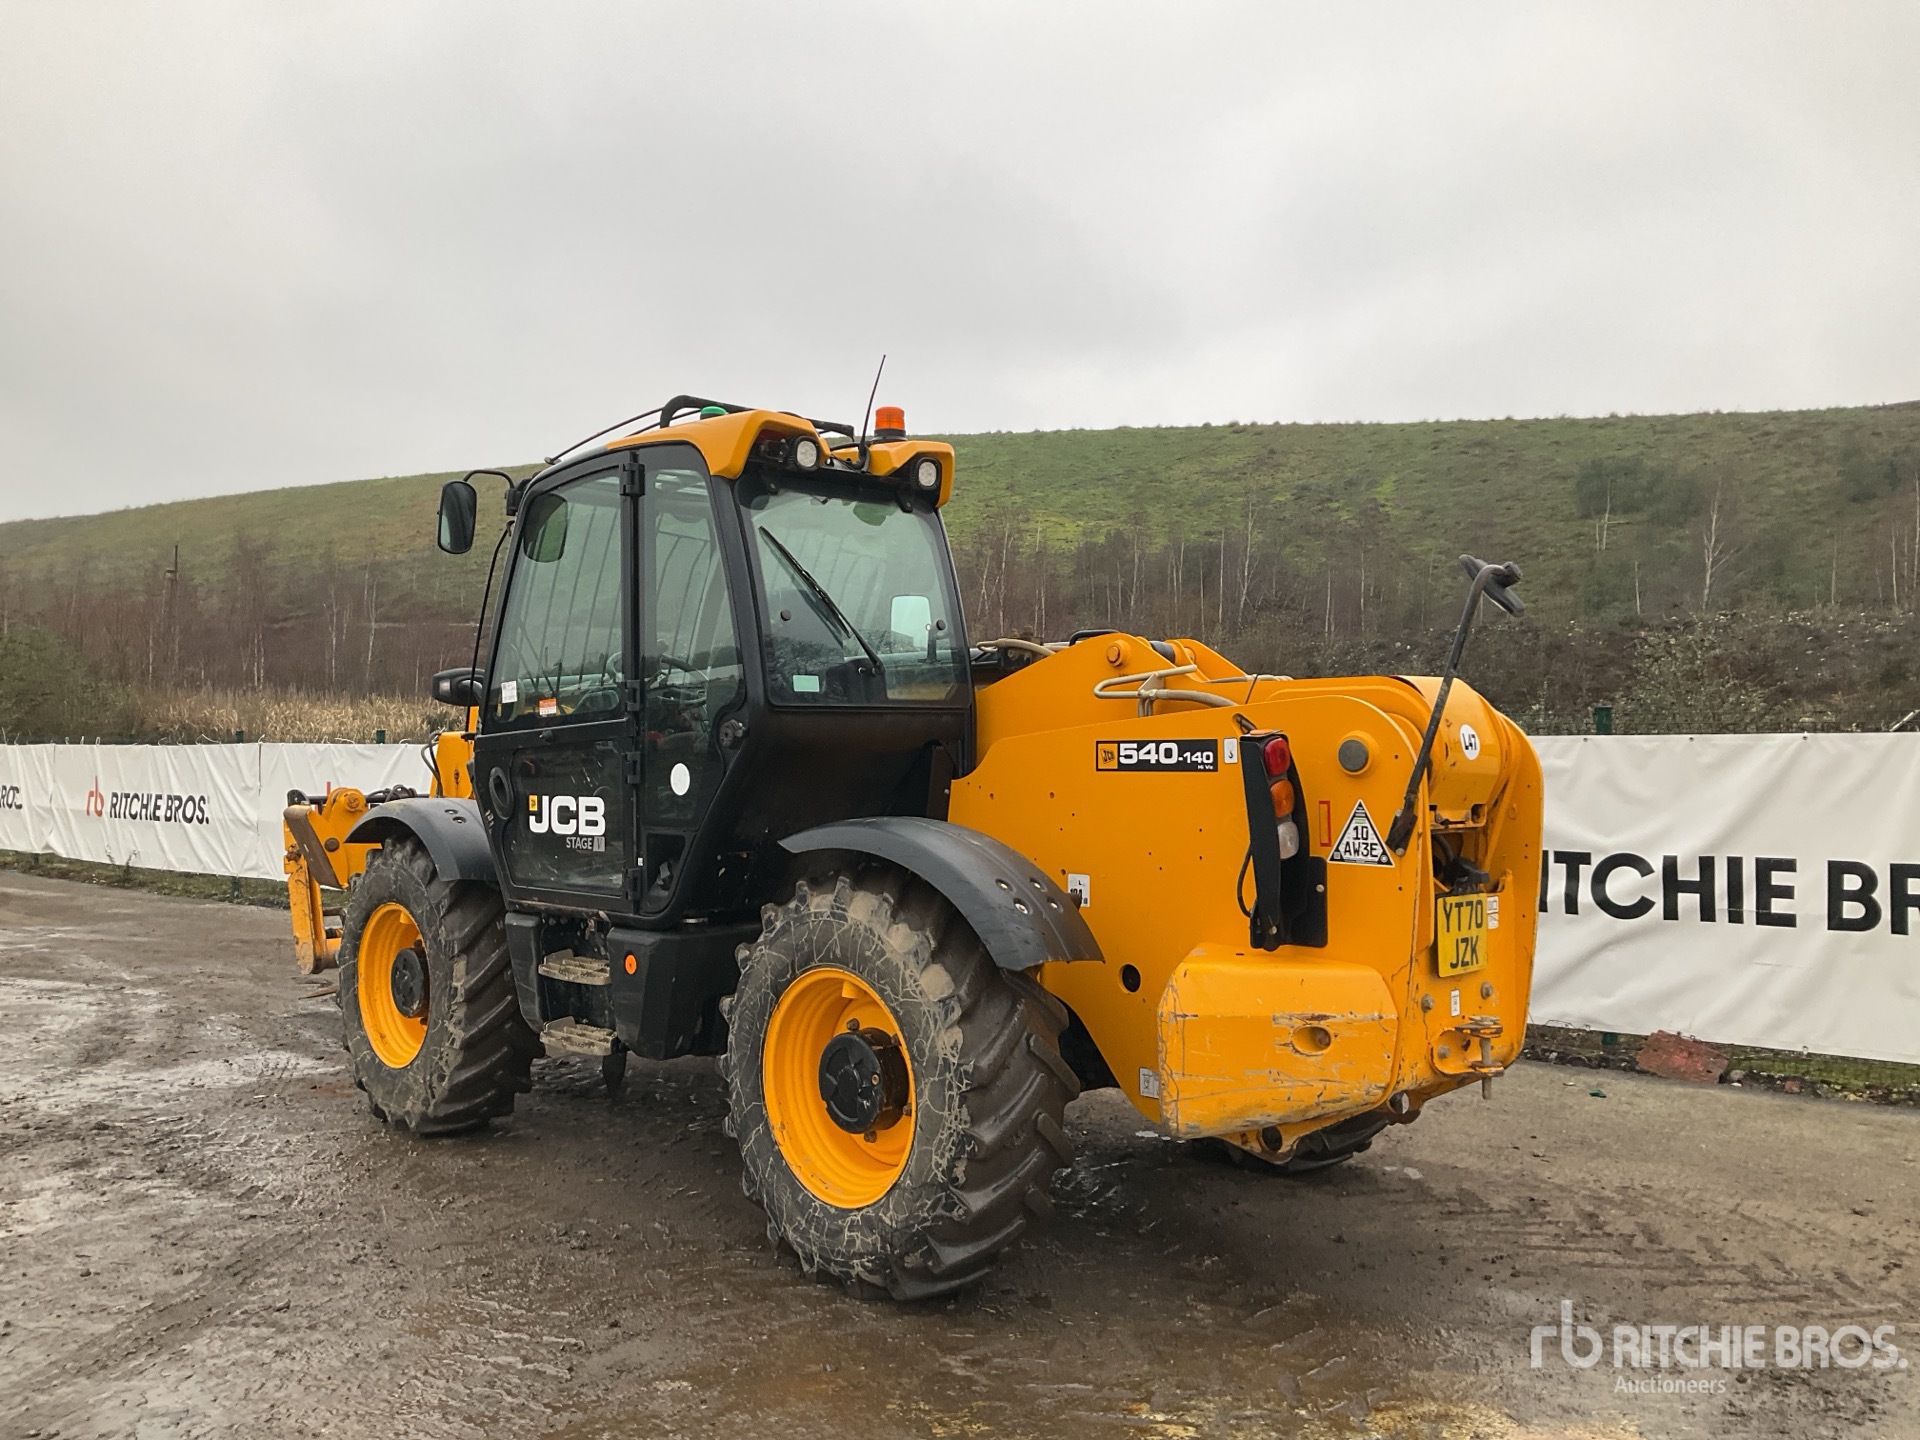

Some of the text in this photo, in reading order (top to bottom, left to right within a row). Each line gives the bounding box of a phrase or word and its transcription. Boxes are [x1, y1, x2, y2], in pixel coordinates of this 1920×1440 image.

[110, 792, 162, 821] RITCHIE
[165, 795, 209, 824] BROS.
[529, 795, 605, 835] JCB
[566, 837, 592, 849] STAGE
[1344, 842, 1378, 857] AW3E
[1539, 850, 1797, 928] ITCHIE
[1443, 899, 1483, 932] YT70
[1450, 935, 1479, 969] JZK
